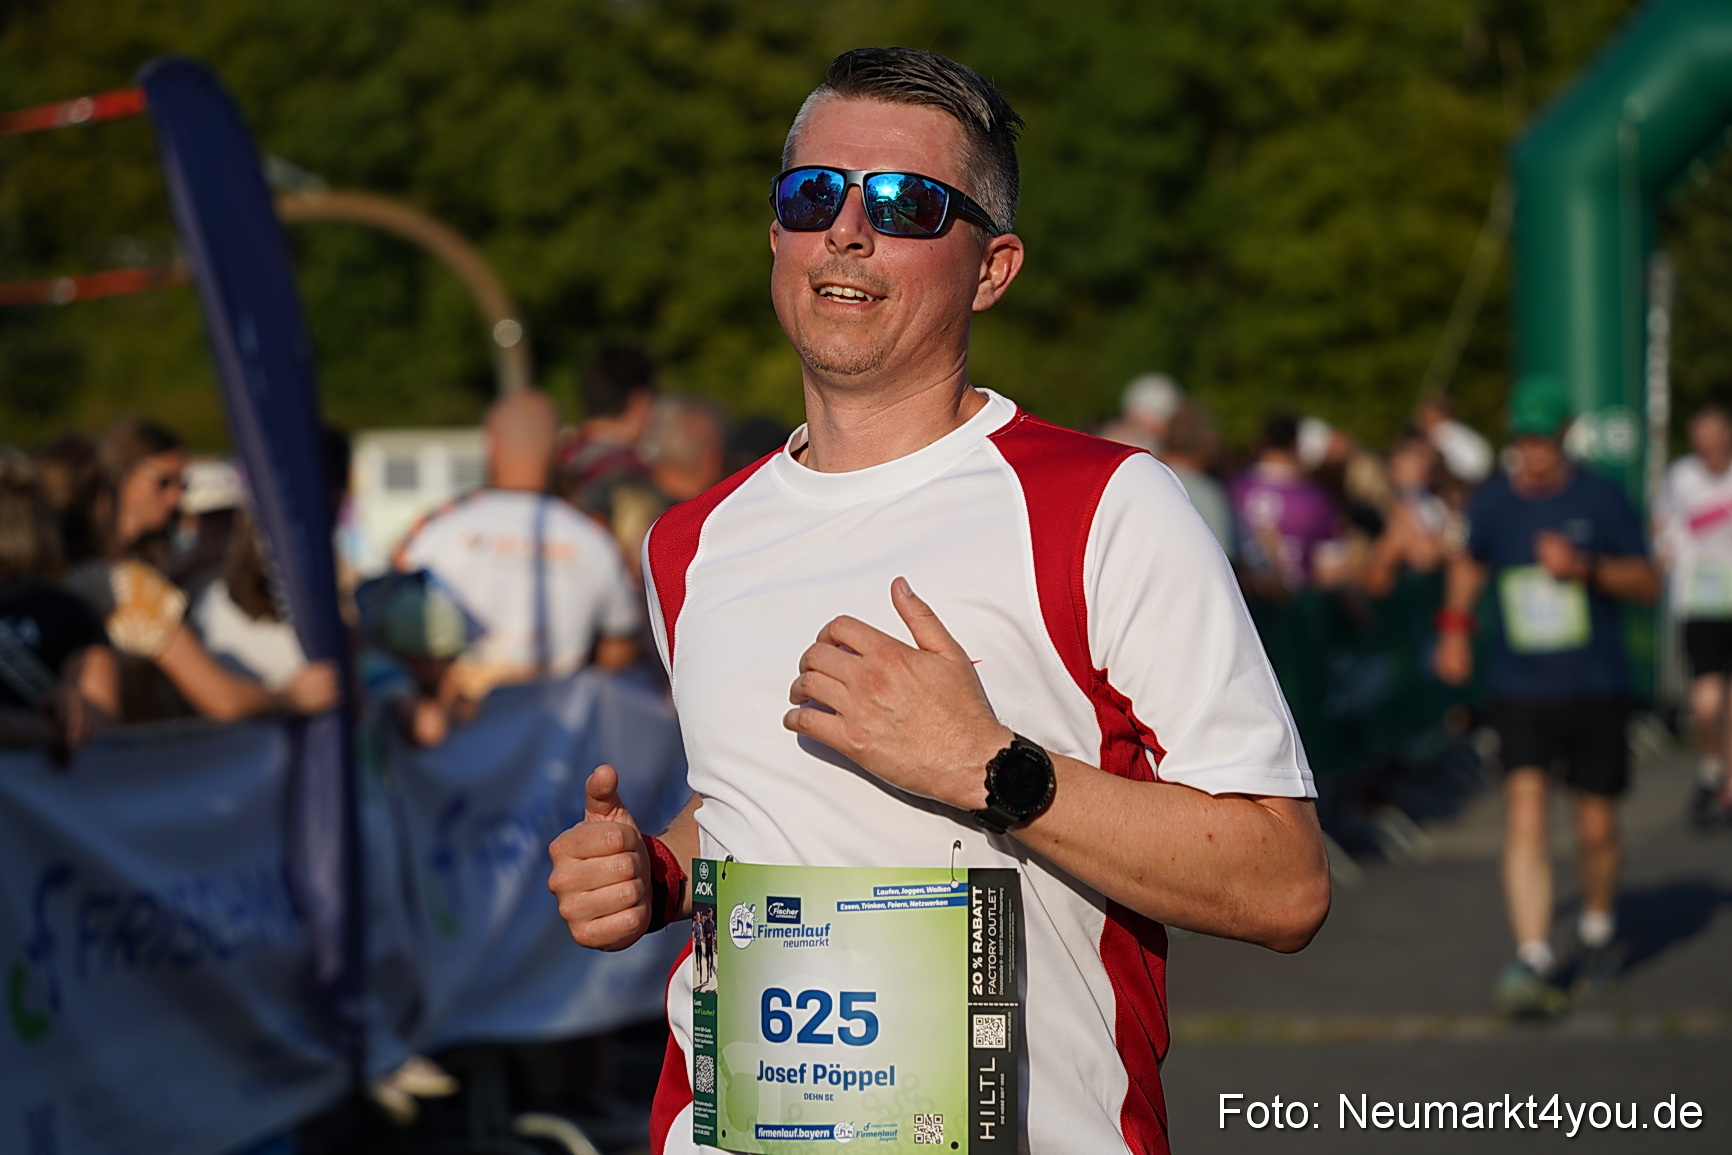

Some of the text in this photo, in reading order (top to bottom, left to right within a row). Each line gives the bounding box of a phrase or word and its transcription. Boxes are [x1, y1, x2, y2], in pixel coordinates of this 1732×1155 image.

[695, 881, 713, 896] AOK
[876, 885, 952, 896] Laufen, Joggen, Walken
[772, 906, 800, 916] Fischer
[840, 899, 949, 911] Essen, Trinken, Feiern, Netzwerken
[757, 923, 831, 938] Firmenlauf
[783, 937, 830, 948] neumarkt
[972, 885, 983, 996] 20 % RABATT
[988, 887, 997, 995] FACTORY OUTLET
[761, 987, 879, 1046] 625
[756, 1060, 895, 1091] Josef Pöppel
[803, 1093, 823, 1101] DEHN
[979, 1057, 996, 1140] HILTL
[757, 1126, 830, 1140] firmenlauf.bayern
[856, 1129, 898, 1138] Firmenlauf
